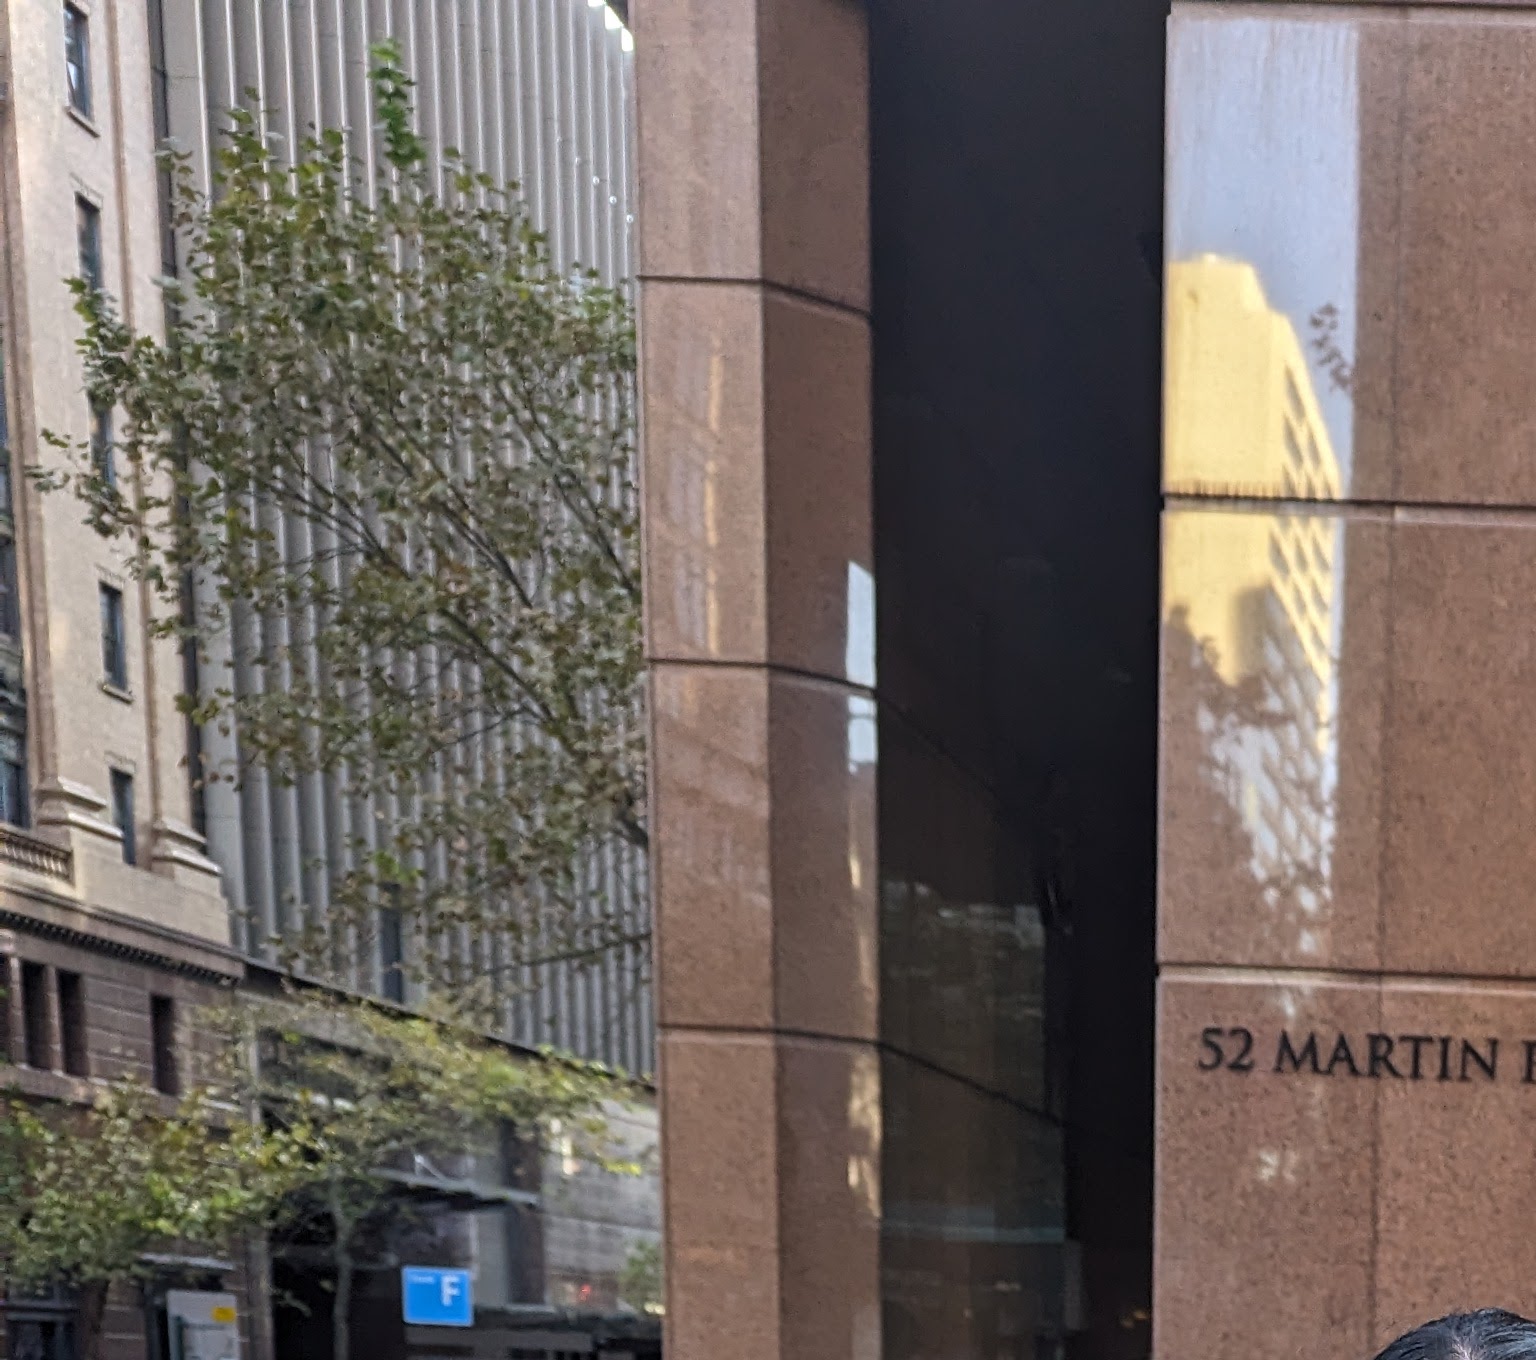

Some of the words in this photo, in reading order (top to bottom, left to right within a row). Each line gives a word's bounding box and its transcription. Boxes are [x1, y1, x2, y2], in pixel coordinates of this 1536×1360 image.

[1197, 1027, 1255, 1072] 52
[1273, 1029, 1500, 1083] MARTIN
[441, 1274, 461, 1308] F
